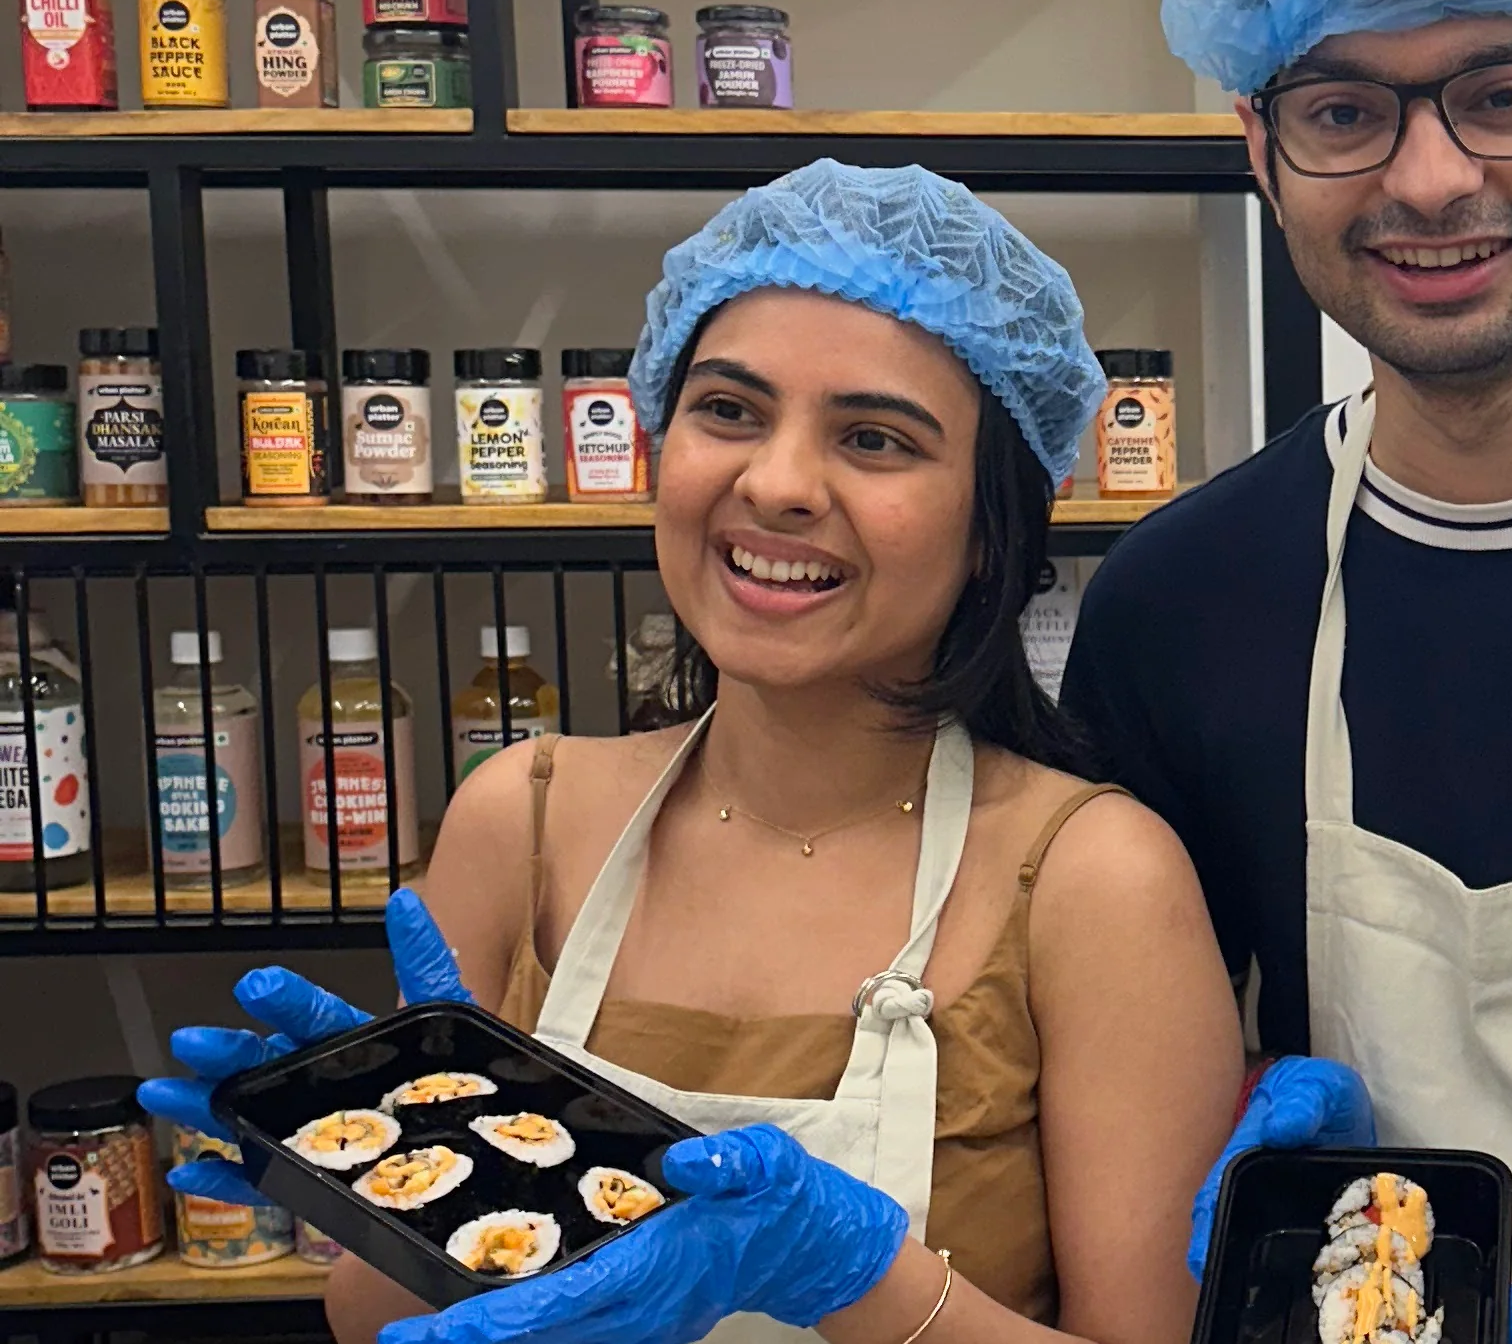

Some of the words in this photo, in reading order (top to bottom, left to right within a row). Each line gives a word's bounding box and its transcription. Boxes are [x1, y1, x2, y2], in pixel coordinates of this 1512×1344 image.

[44, 11, 68, 27] OIL
[270, 23, 296, 31] urban
[151, 36, 201, 49] BLACK
[150, 51, 204, 65] PEPPER
[262, 56, 307, 69] HING
[152, 66, 202, 79] SAUCE
[369, 404, 398, 413] urban
[104, 411, 145, 423] PARSI
[367, 413, 400, 422] platter
[92, 423, 161, 435] DHANSAK
[252, 416, 304, 434] Korean
[97, 436, 156, 448] MASALA
[356, 430, 413, 445] Sumac
[471, 432, 523, 445] LEMON
[1107, 437, 1154, 446] CAYENNE
[354, 444, 416, 458] Powder
[471, 446, 525, 457] PEPPER
[578, 443, 630, 454] KETCHUP
[1111, 446, 1150, 455] PEPPER
[1109, 456, 1153, 465] POWDER
[49, 1203, 87, 1215] IMLI
[50, 1217, 88, 1228] GOLI
